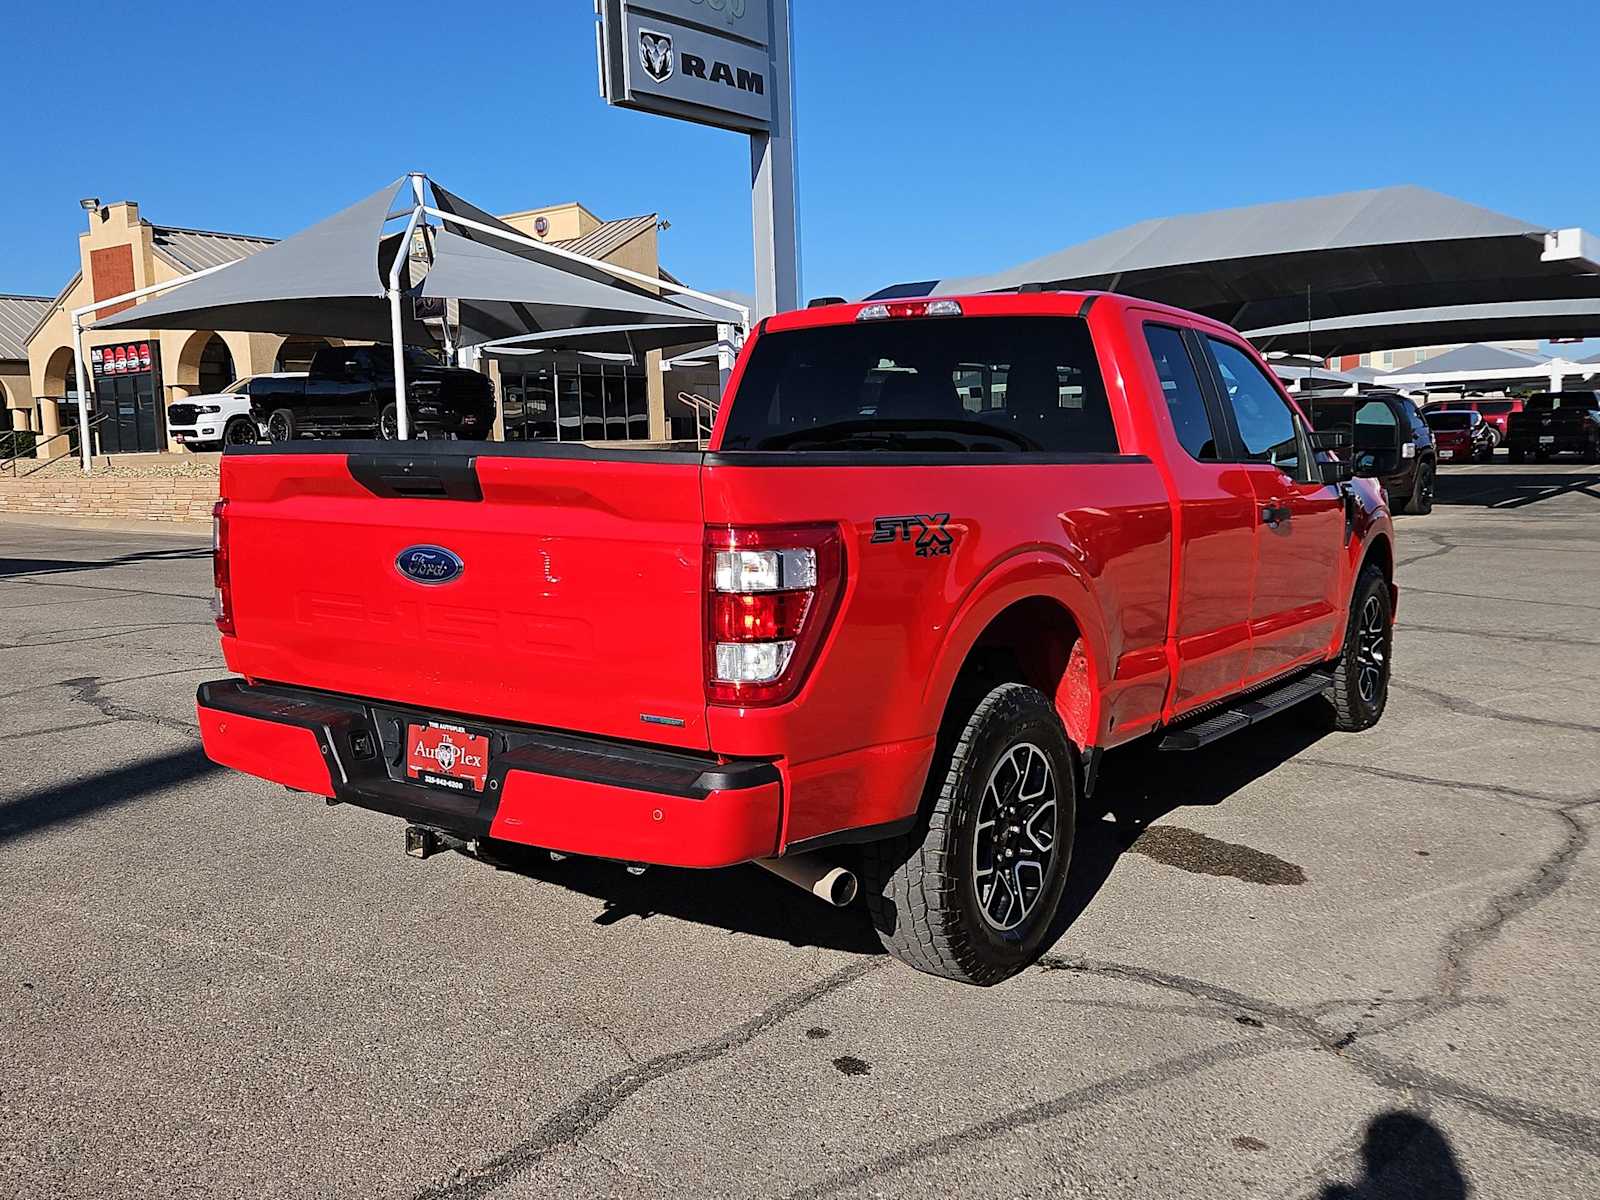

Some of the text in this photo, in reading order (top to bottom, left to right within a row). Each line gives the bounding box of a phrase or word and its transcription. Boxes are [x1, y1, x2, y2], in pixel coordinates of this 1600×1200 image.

[680, 52, 764, 96] RAM
[870, 512, 954, 548] STX
[294, 588, 594, 661] F-150
[442, 734, 453, 744] The
